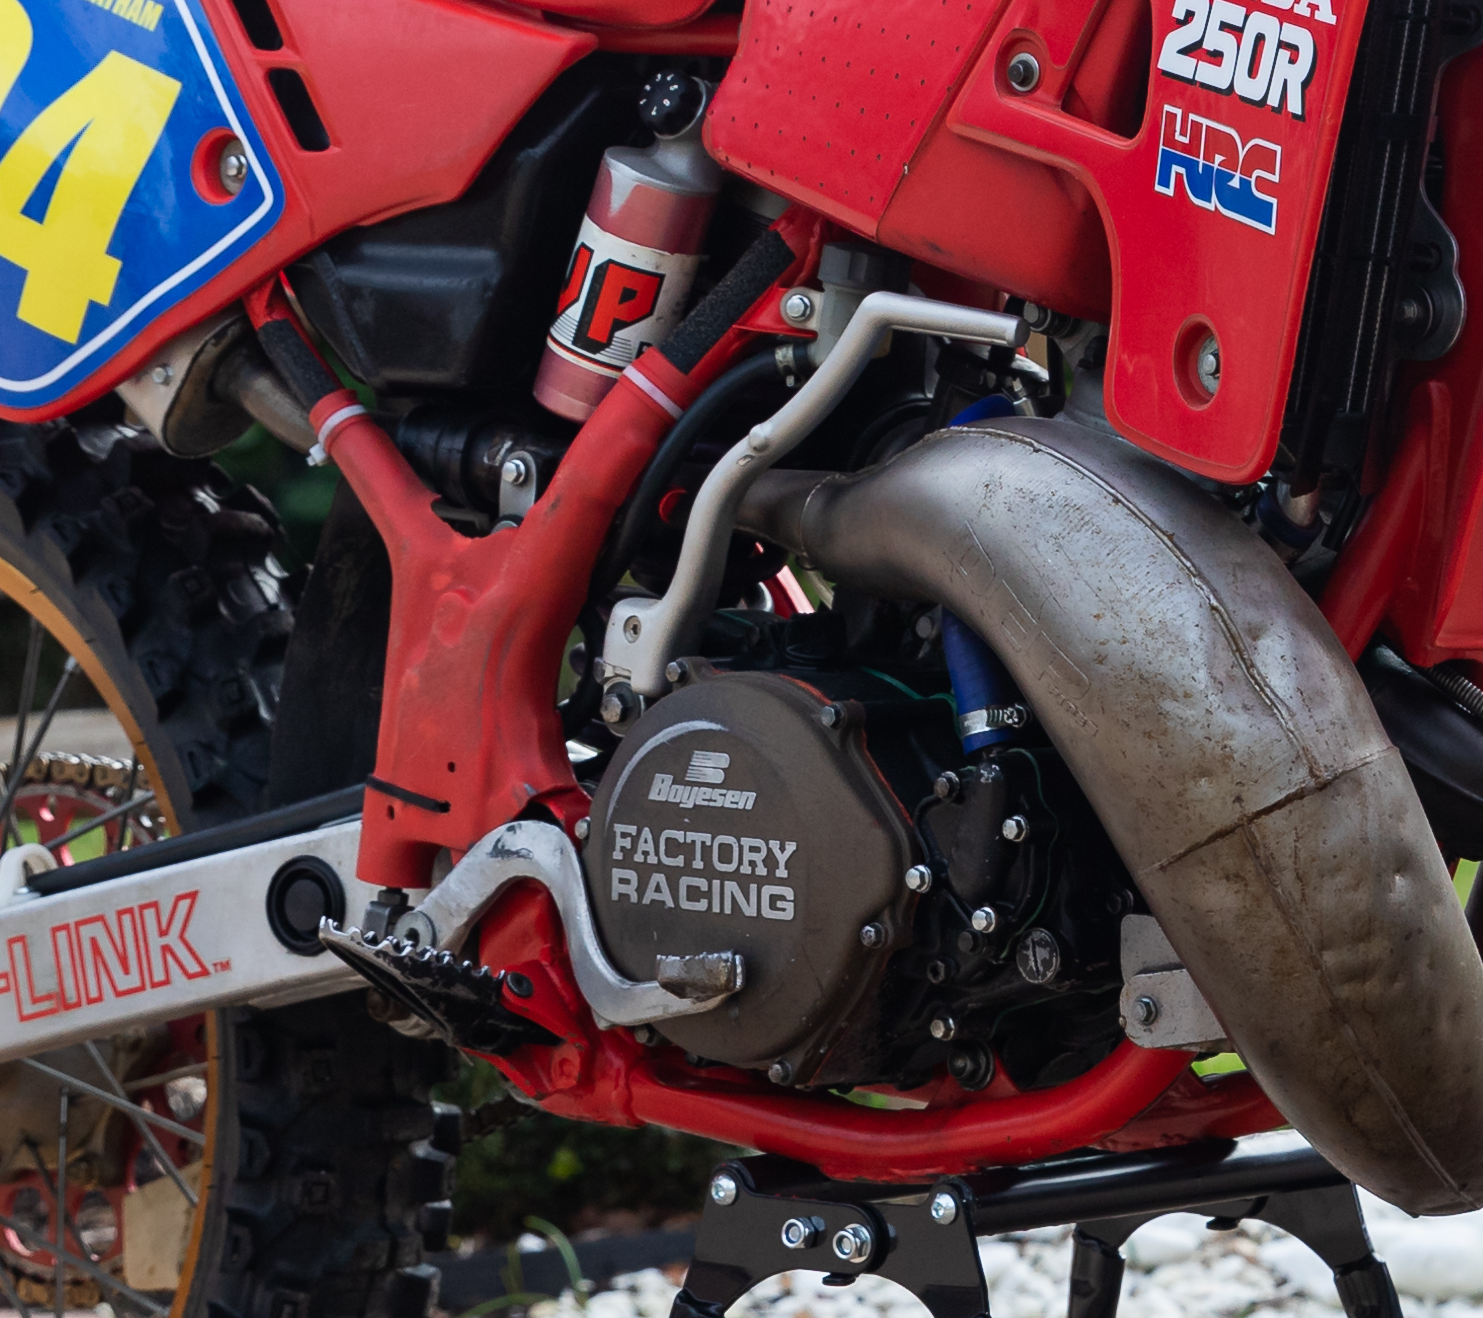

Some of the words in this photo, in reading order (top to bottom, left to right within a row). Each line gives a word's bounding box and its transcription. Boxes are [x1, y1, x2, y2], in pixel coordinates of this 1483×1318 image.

[1154, 103, 1282, 236] HRC
[648, 773, 757, 810] Boyesen
[612, 823, 798, 879] FACTORY
[611, 867, 795, 921] RACING
